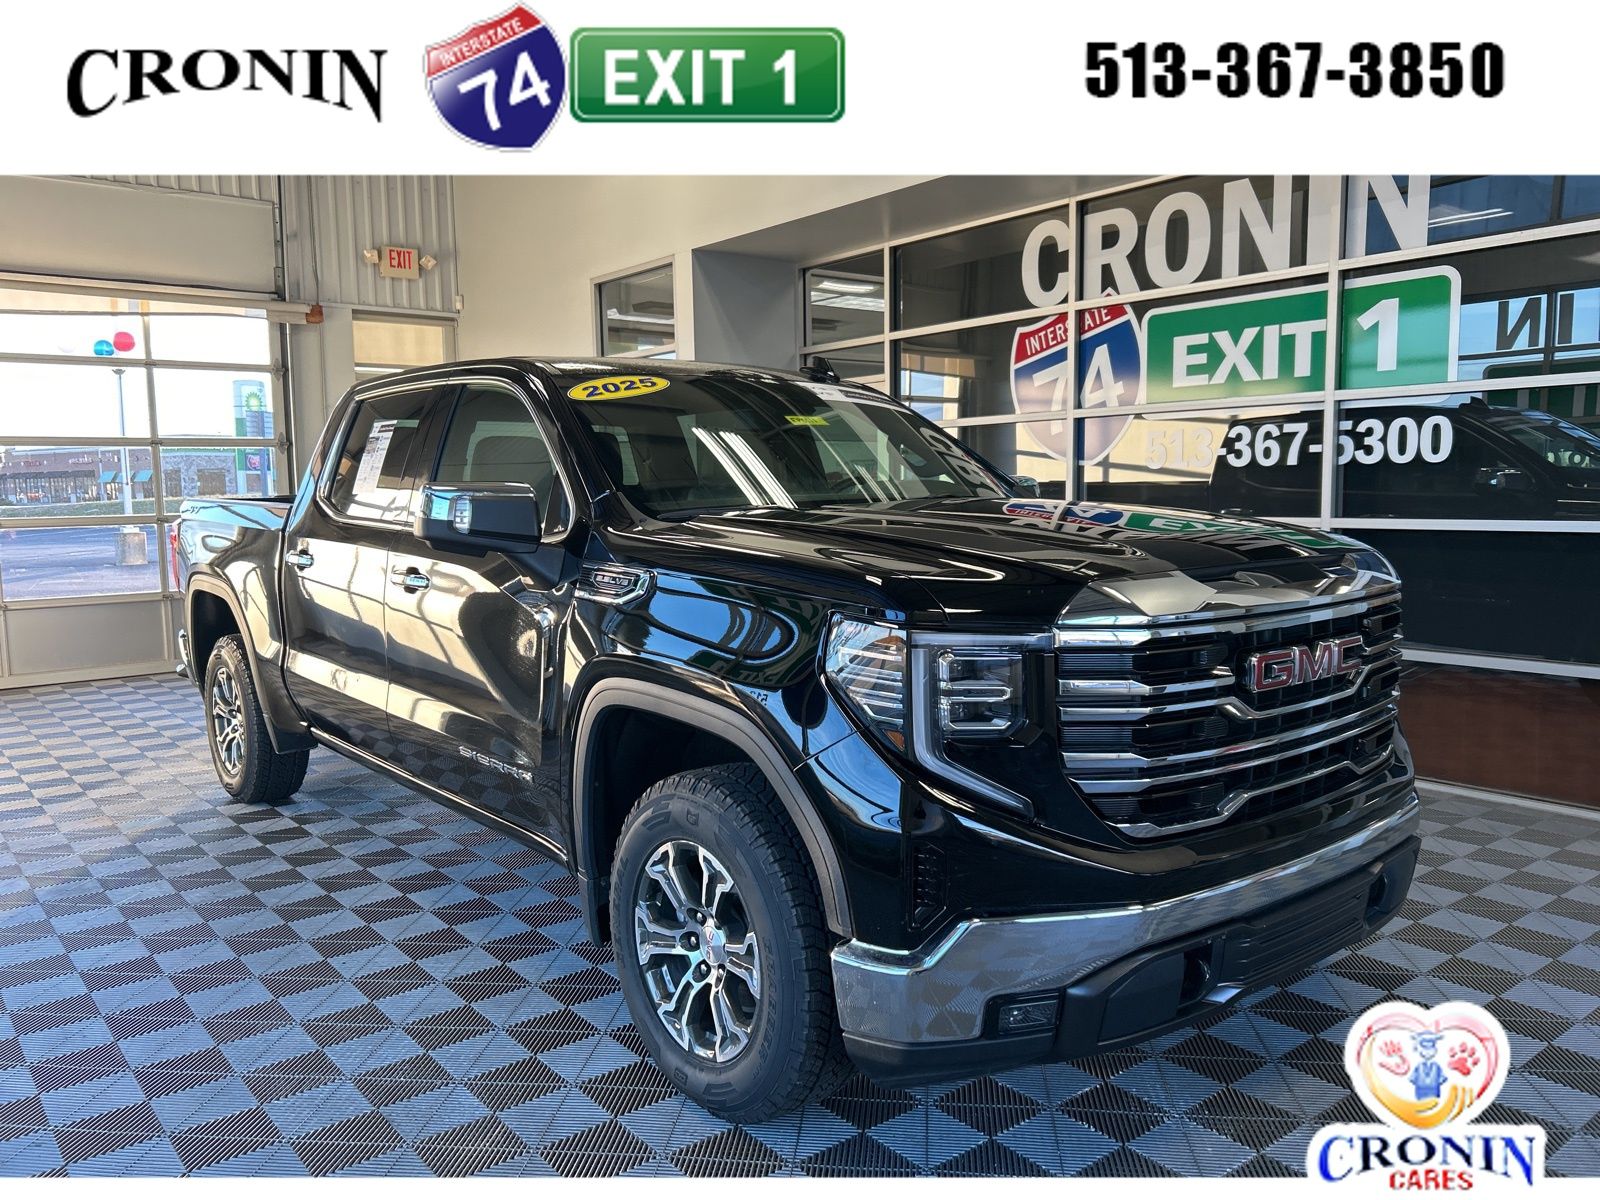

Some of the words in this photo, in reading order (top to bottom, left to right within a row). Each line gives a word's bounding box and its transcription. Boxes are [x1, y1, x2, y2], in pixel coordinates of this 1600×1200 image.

[389, 249, 412, 270] EXIT
[1021, 175, 1430, 308] CRONIN
[1025, 308, 1112, 356] INTERATE
[1172, 319, 1328, 389] EXIT
[1356, 297, 1400, 372] 1
[582, 377, 657, 398] 2025
[1032, 343, 1126, 435] 74
[1145, 415, 1453, 470] 513-367-5300
[1246, 634, 1363, 693] GMC
[458, 745, 534, 785] SIERRA
